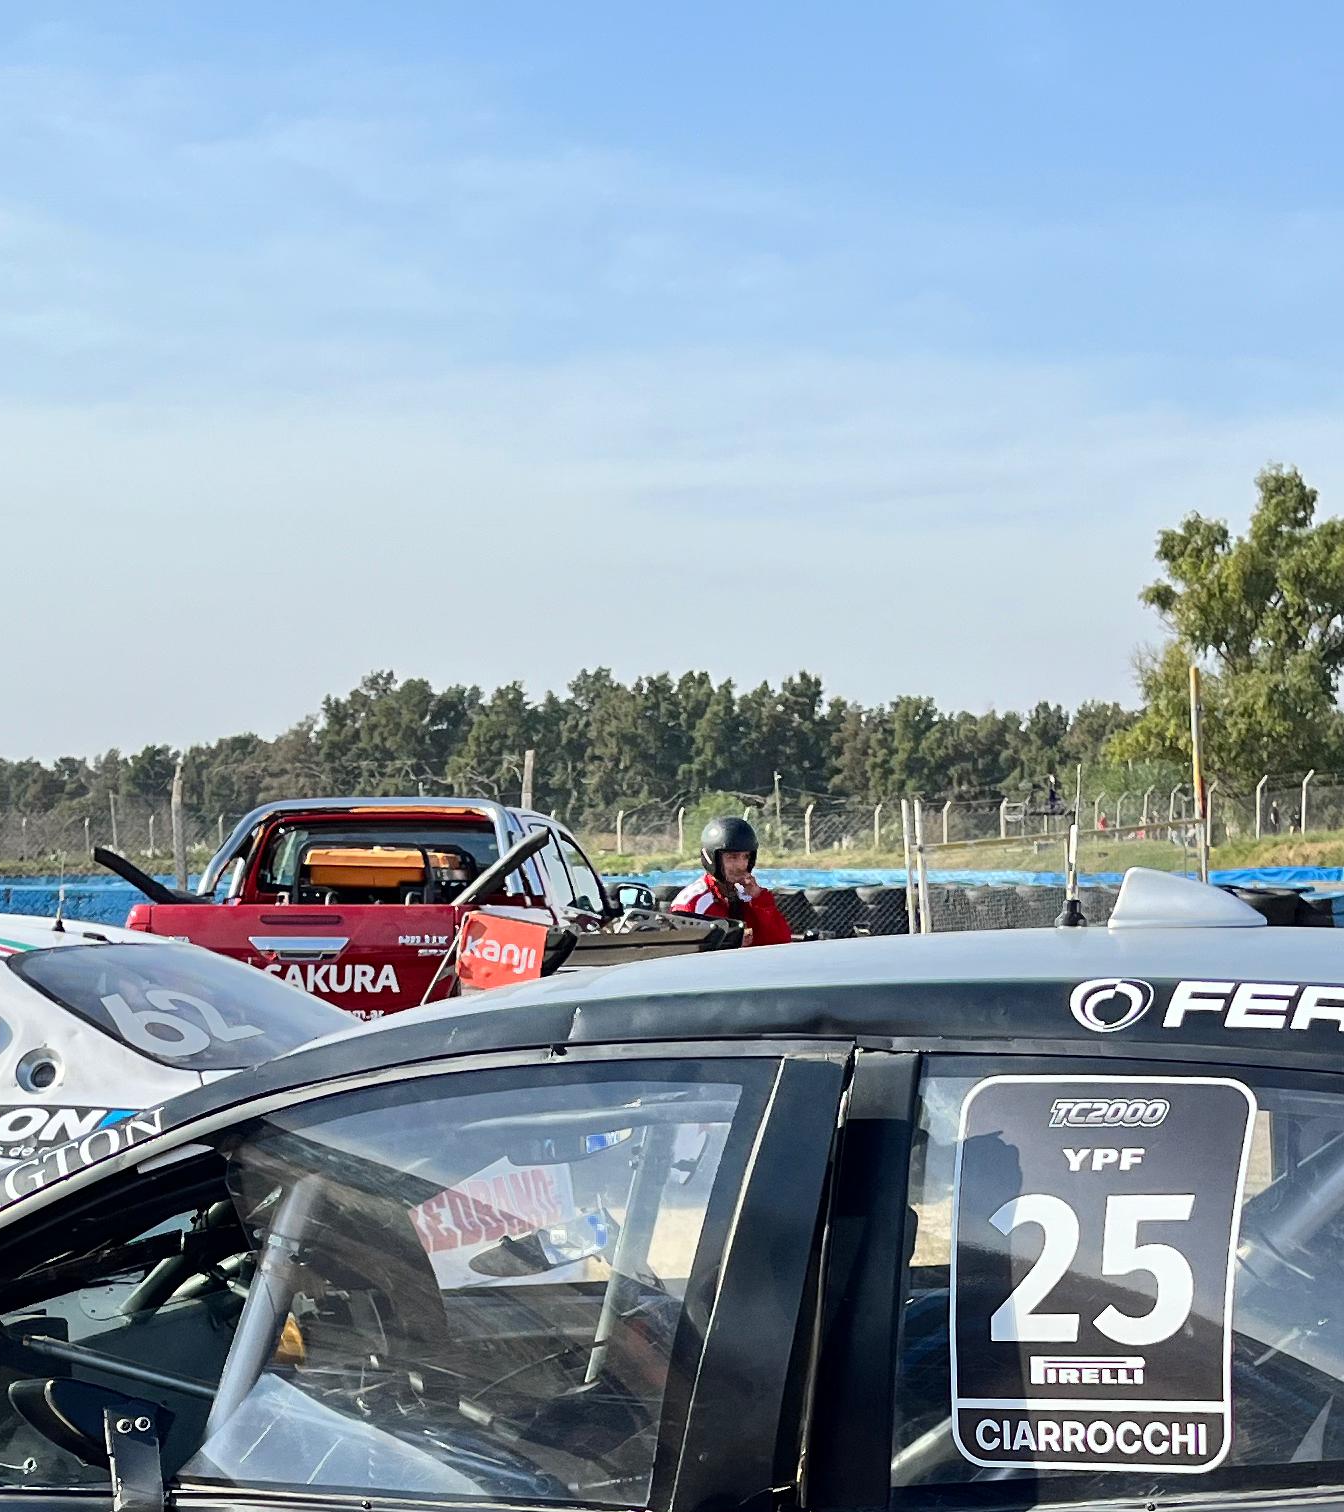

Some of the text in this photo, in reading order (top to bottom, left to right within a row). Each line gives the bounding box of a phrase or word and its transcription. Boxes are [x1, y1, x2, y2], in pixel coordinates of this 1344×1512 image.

[99, 989, 266, 1057] 62
[1049, 1098, 1171, 1129] TC2000
[1061, 1147, 1146, 1172] YPF
[988, 1193, 1196, 1346] 25
[1030, 1355, 1146, 1385] PIRELLI
[974, 1418, 1208, 1456] CIARROCCHI
